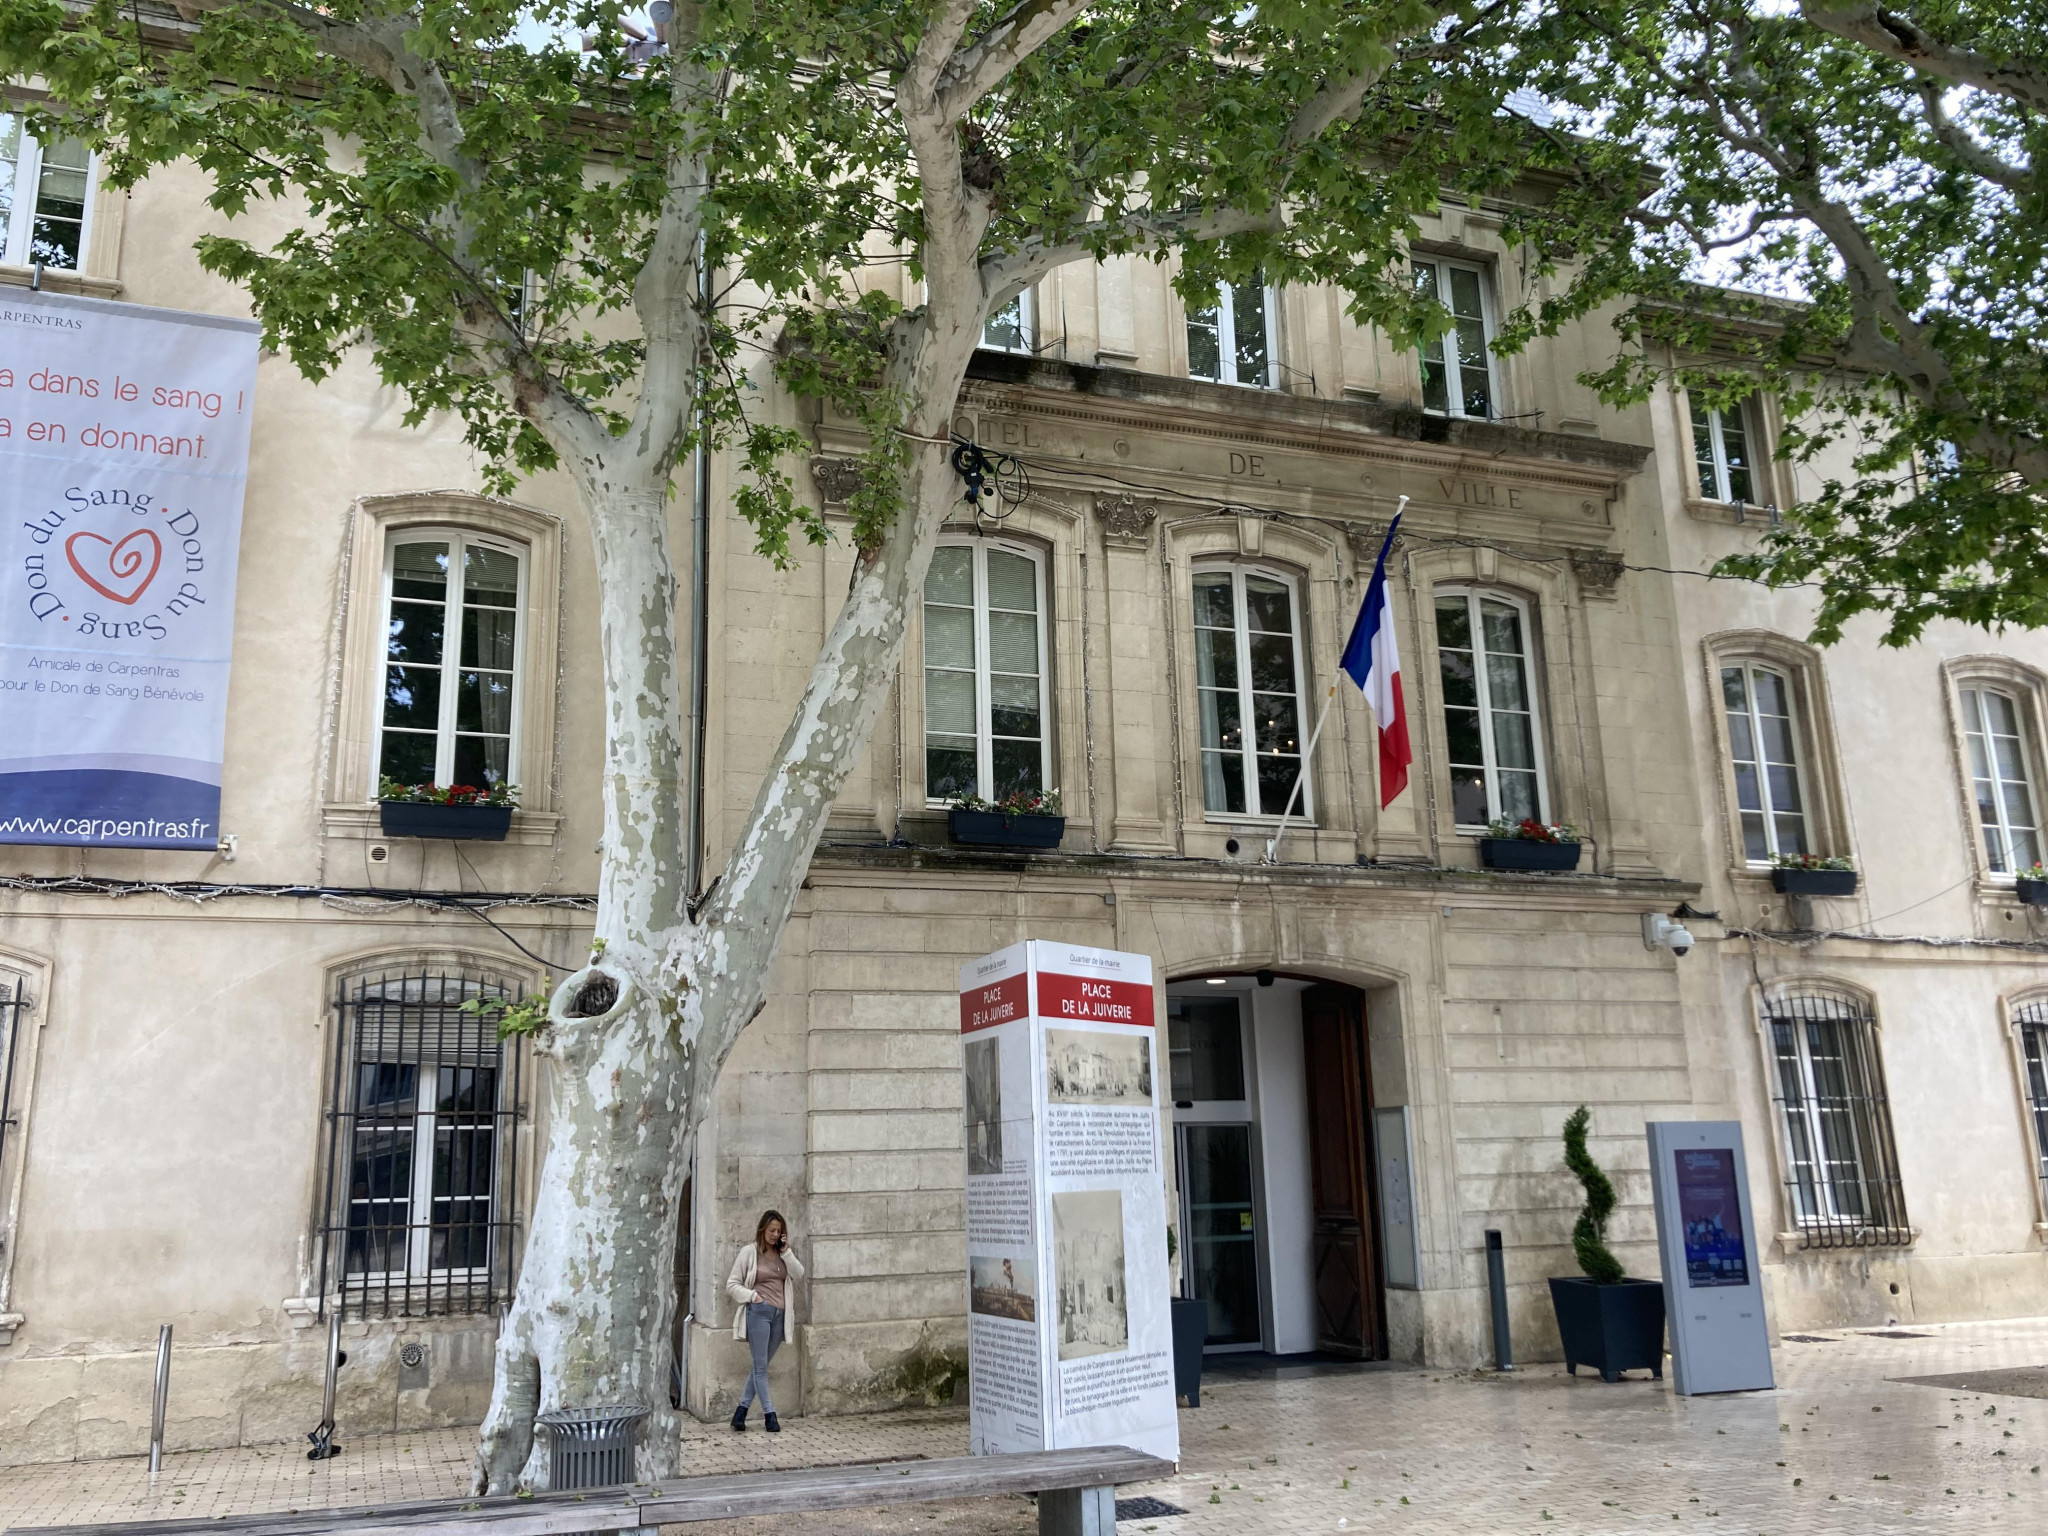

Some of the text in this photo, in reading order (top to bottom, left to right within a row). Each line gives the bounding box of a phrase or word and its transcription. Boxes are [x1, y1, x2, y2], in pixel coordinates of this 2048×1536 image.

[0, 311, 82, 329] RPENTRAS
[29, 368, 100, 398] dans
[114, 375, 138, 402] le
[152, 387, 222, 418] sang
[26, 421, 66, 443] en
[80, 422, 208, 459] donnant.
[1229, 452, 1265, 477] DE
[1438, 479, 1523, 510] VILLE
[24, 487, 154, 622] Don du Sang
[76, 508, 206, 641] Don du Sang
[28, 656, 180, 678] Amicale de Carpentras
[34, 680, 46, 692] le
[50, 681, 78, 694] Don
[83, 683, 100, 695] de
[106, 684, 139, 700] Sang
[144, 686, 204, 702] Bénévole
[0, 817, 210, 840] www.carpentras.fr
[1070, 954, 1090, 963] Quartier
[984, 986, 1001, 1004] PLACE
[1082, 982, 1111, 998] PLACE
[973, 1002, 1014, 1026] DE LA JUIVERIE
[1062, 999, 1132, 1019] DE LA JUIVERIE
